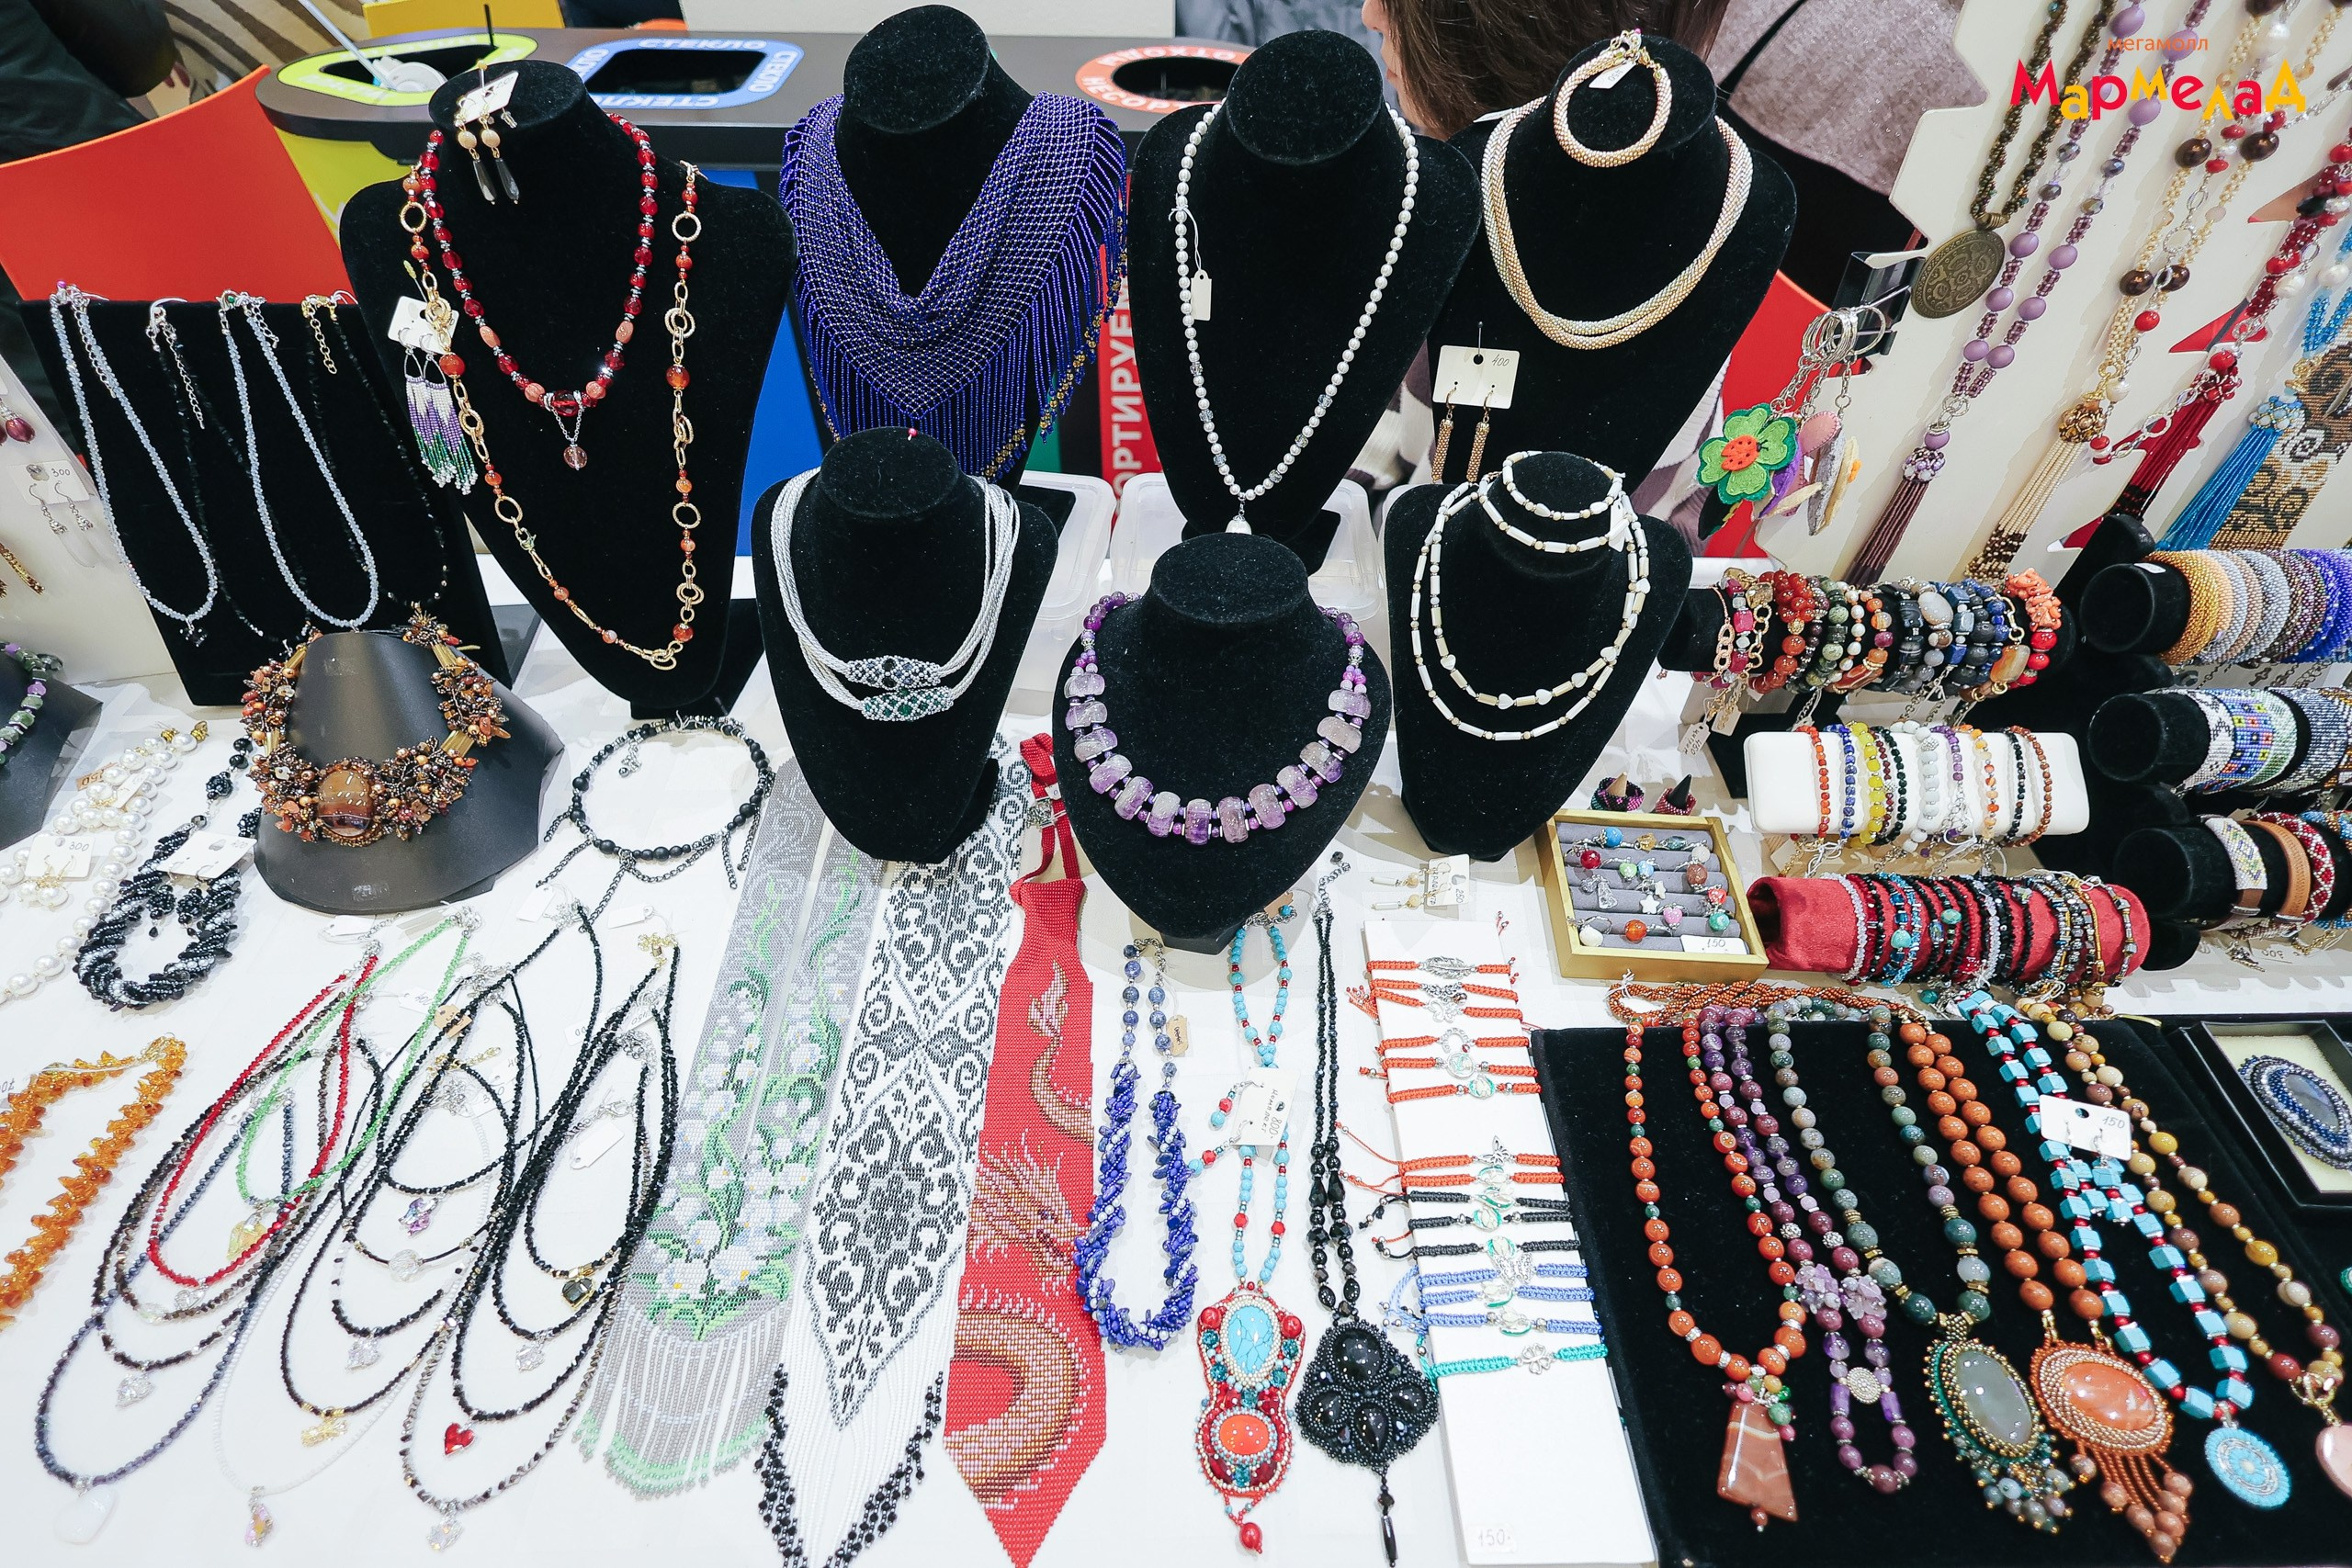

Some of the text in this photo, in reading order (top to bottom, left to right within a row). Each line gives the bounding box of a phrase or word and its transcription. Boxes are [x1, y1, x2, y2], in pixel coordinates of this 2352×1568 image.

[639, 38, 768, 50] СТЕКЛО
[1097, 46, 1237, 66] ОТХОДЫ
[747, 50, 799, 93] СТЕКЛО
[1491, 353, 1510, 367] 400
[51, 467, 71, 478] 300
[68, 840, 89, 852] 300
[1455, 888, 1465, 904] 250
[1706, 938, 1726, 949] 150
[2102, 1116, 2126, 1130] 150
